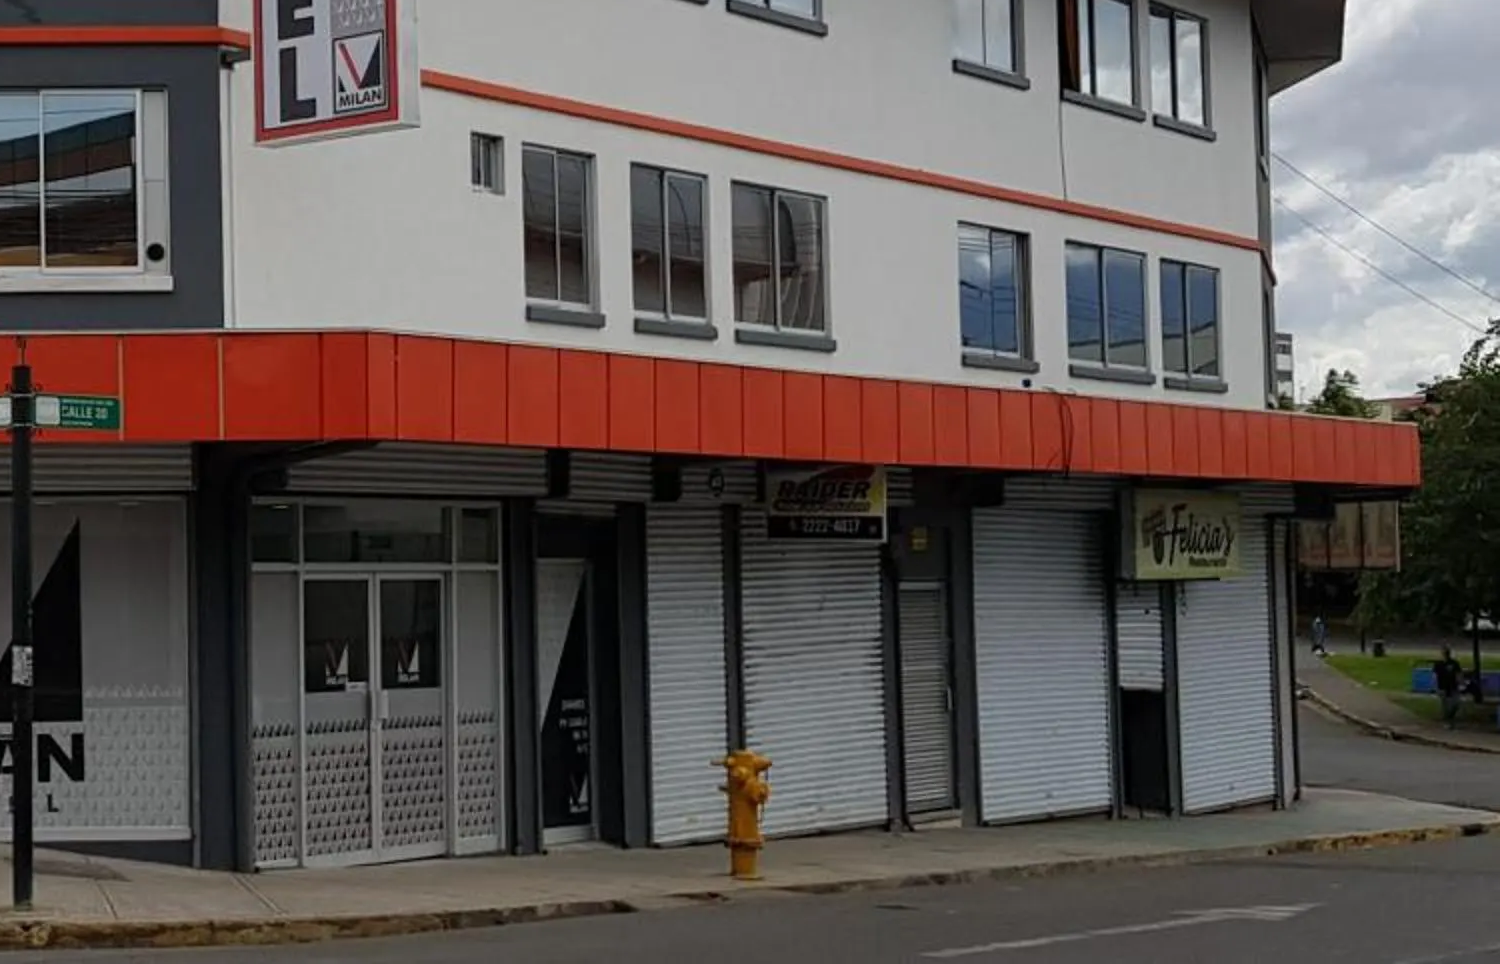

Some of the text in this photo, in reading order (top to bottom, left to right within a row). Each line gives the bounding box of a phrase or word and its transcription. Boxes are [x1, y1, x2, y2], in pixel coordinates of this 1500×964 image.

[339, 88, 381, 107] MILAN
[62, 406, 93, 418] CALLE
[778, 479, 871, 498] RAIDER
